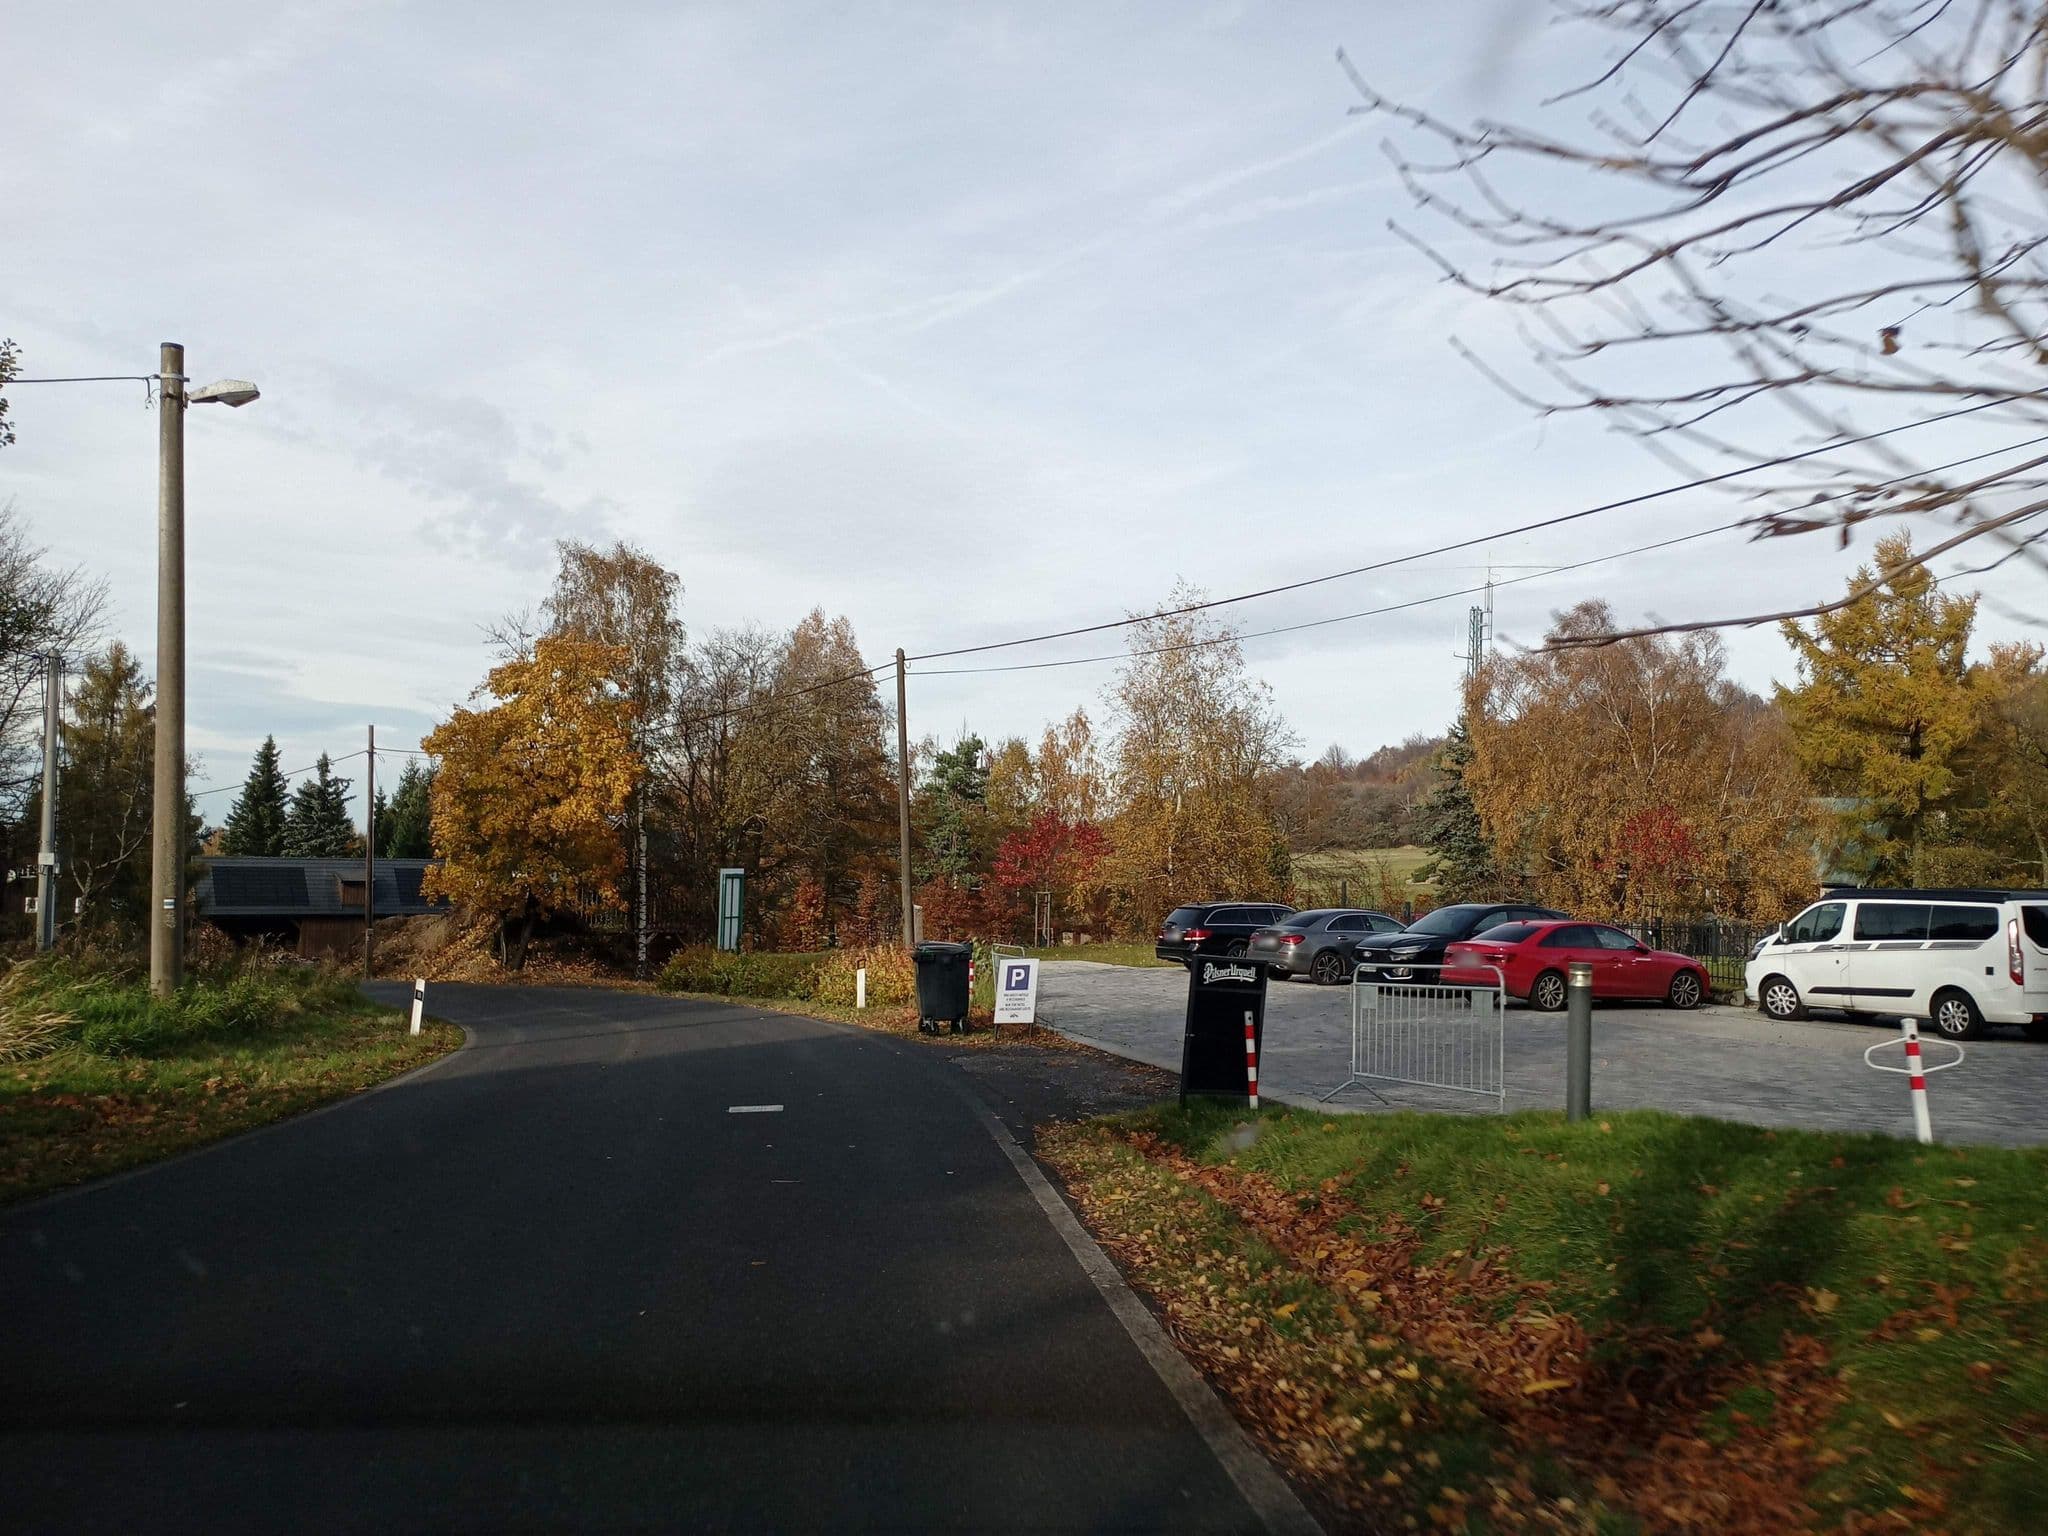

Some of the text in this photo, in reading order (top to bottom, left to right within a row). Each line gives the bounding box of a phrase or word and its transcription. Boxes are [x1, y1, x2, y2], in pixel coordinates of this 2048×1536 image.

[1011, 968, 1025, 988] P
[1203, 962, 1256, 984] Pilsner Urquell
